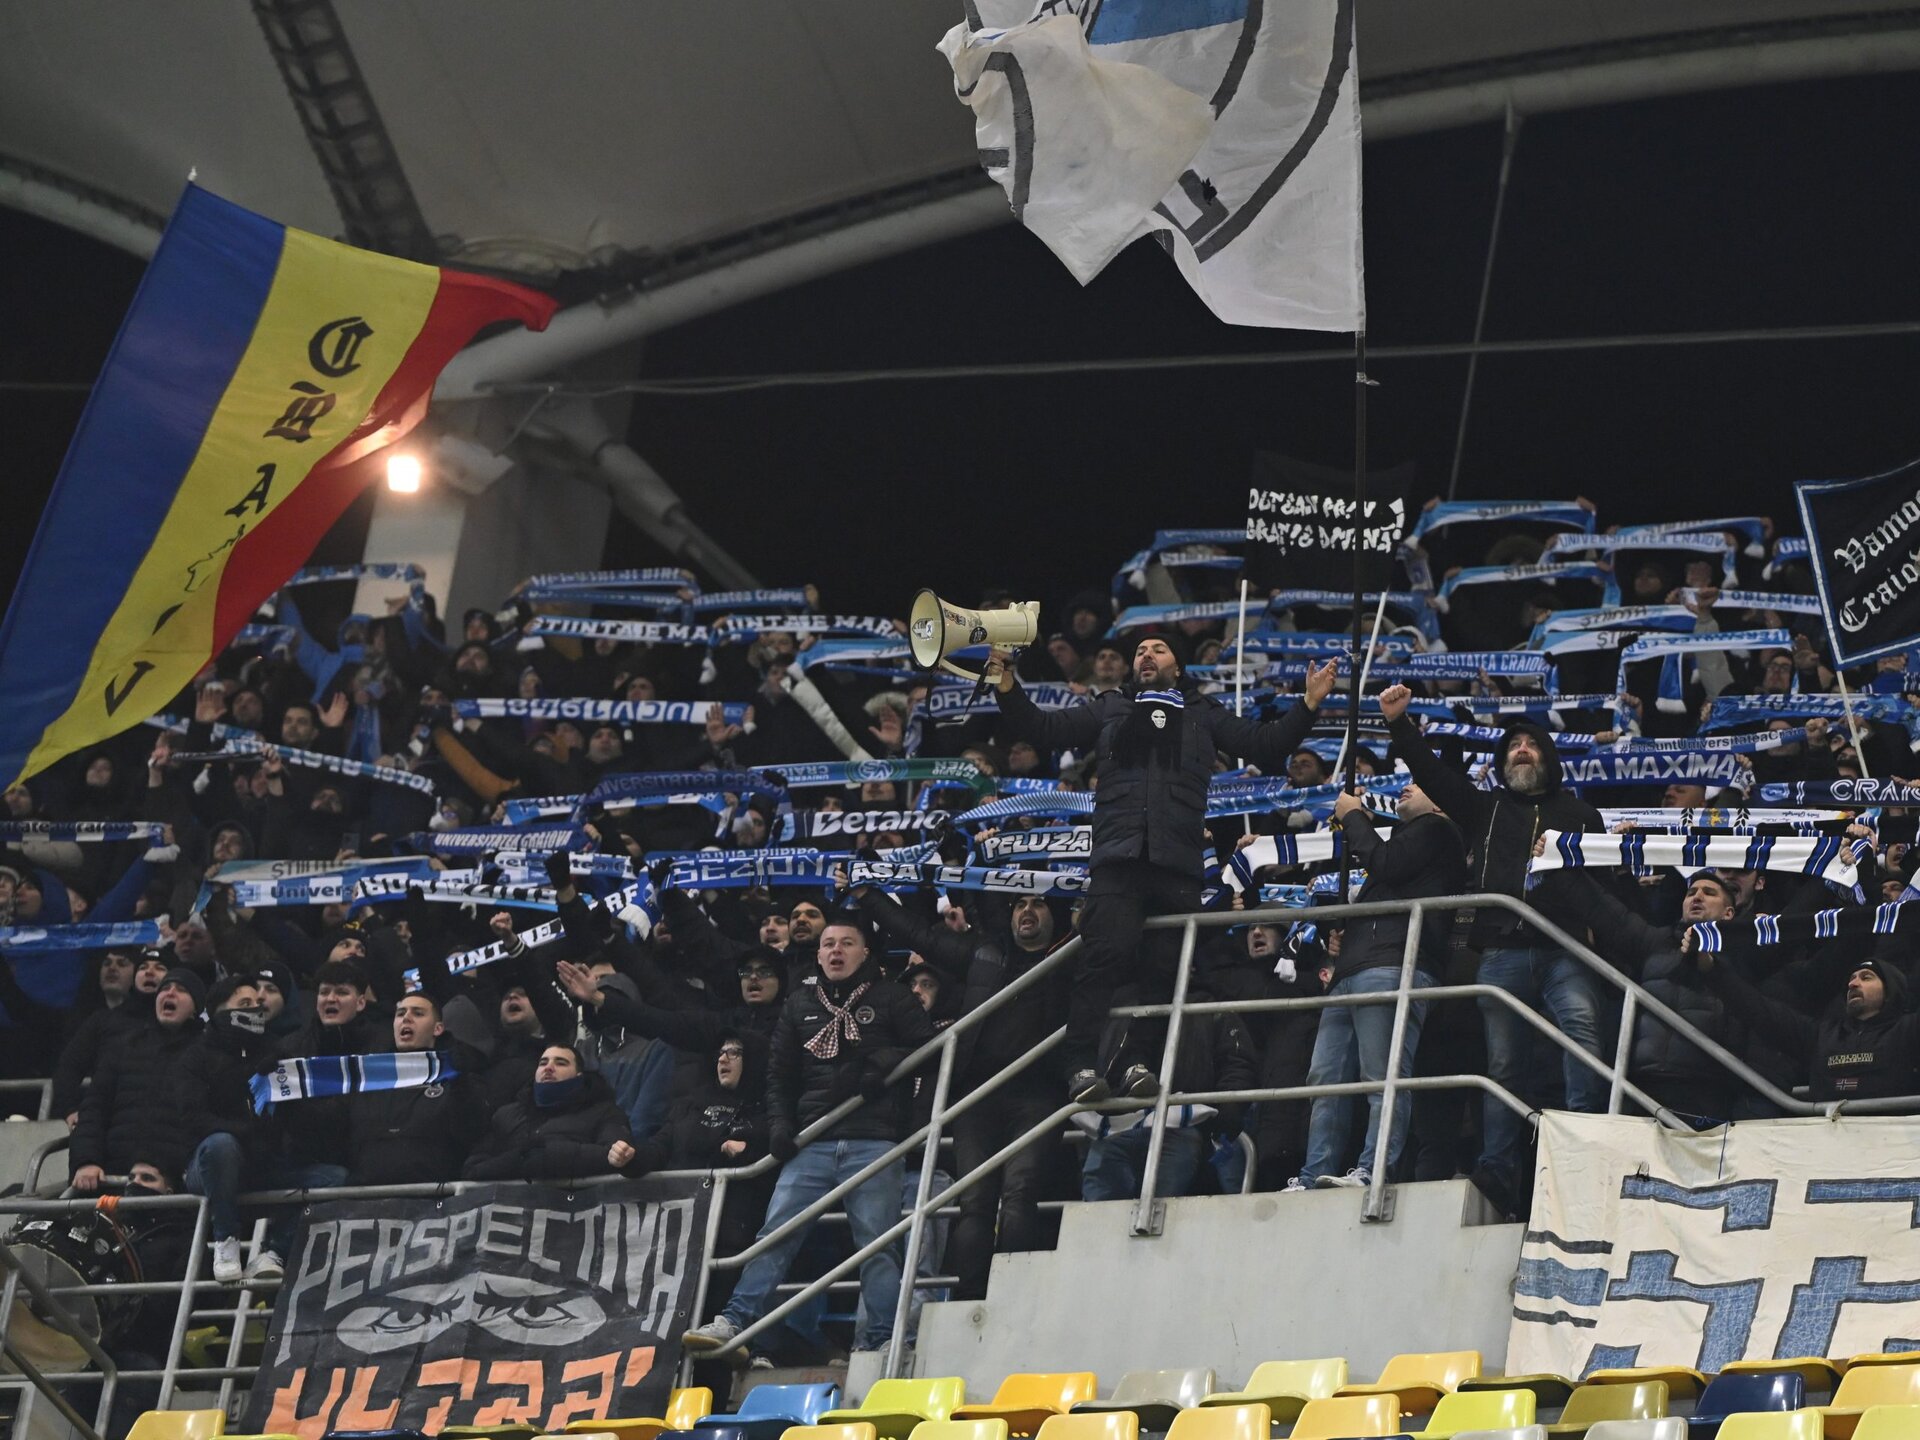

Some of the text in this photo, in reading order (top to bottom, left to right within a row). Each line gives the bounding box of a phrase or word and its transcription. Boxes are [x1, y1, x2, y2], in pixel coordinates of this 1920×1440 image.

[811, 810, 950, 837] Betano
[983, 832, 1091, 860] PELUZA
[984, 870, 1034, 889] LA
[274, 1198, 696, 1366] PERSPECTIVA
